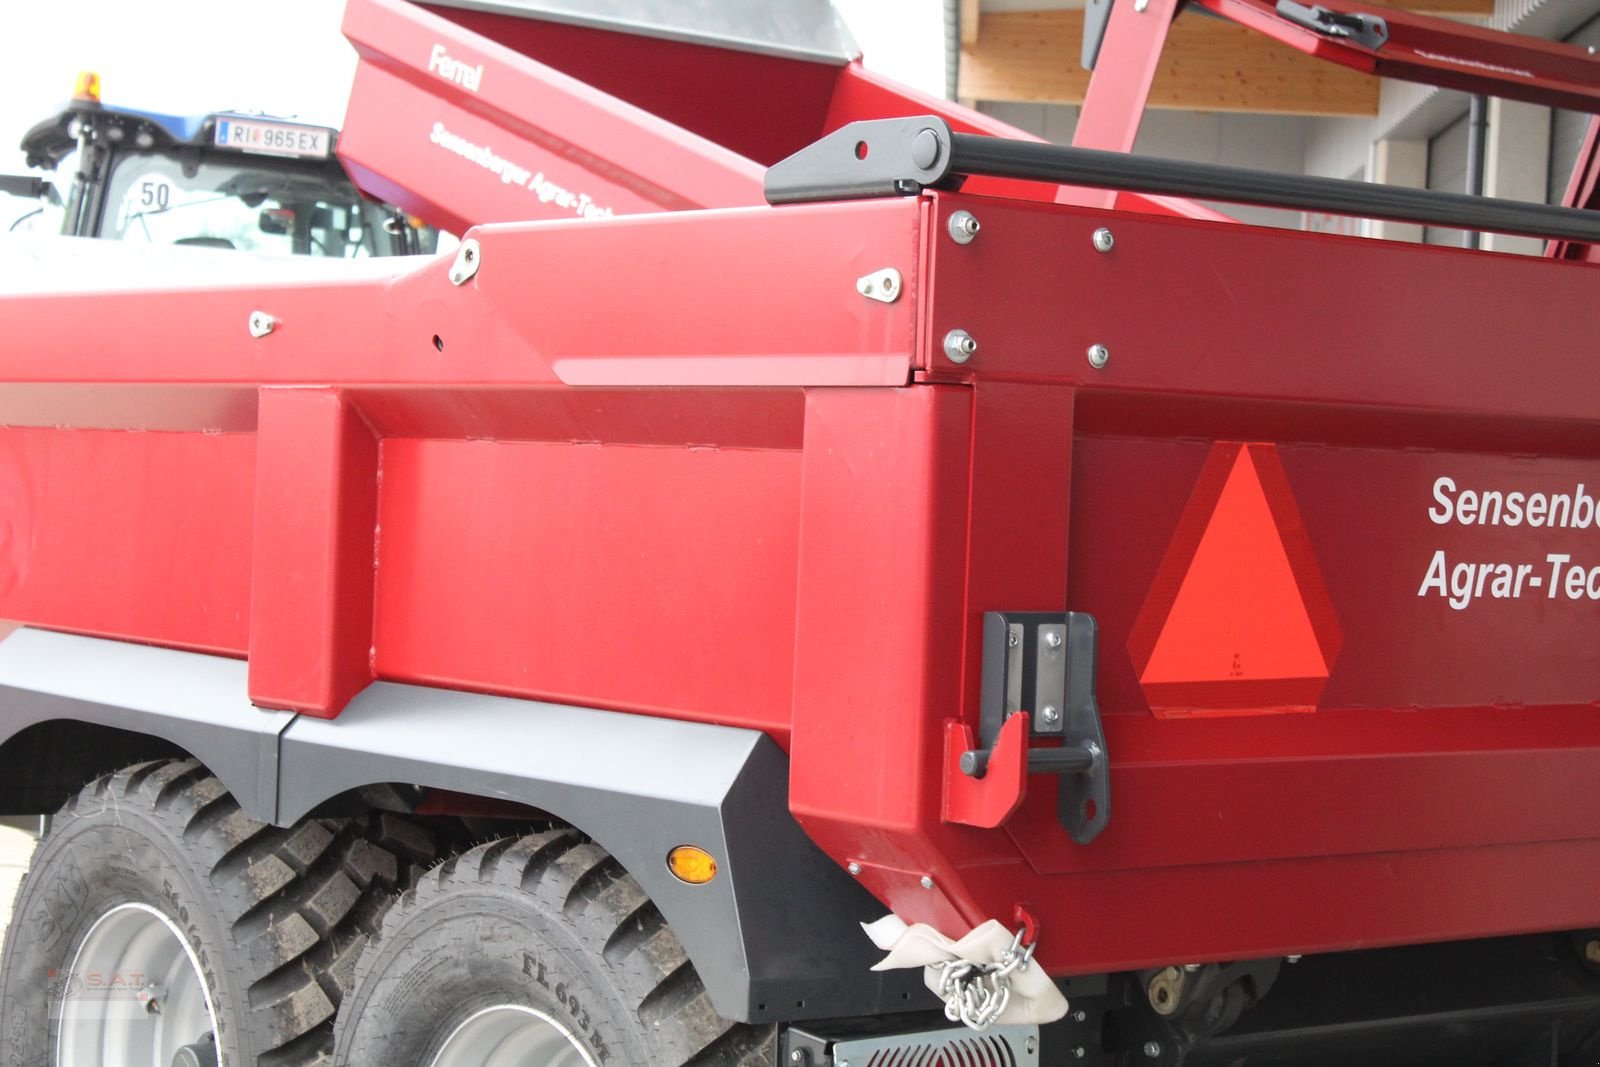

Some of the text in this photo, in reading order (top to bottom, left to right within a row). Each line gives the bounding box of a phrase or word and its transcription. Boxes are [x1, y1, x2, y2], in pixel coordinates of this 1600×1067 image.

[428, 43, 483, 92] Ferrel
[233, 126, 249, 143] RI
[141, 182, 169, 209] 50
[1428, 476, 1600, 529] Sensenb
